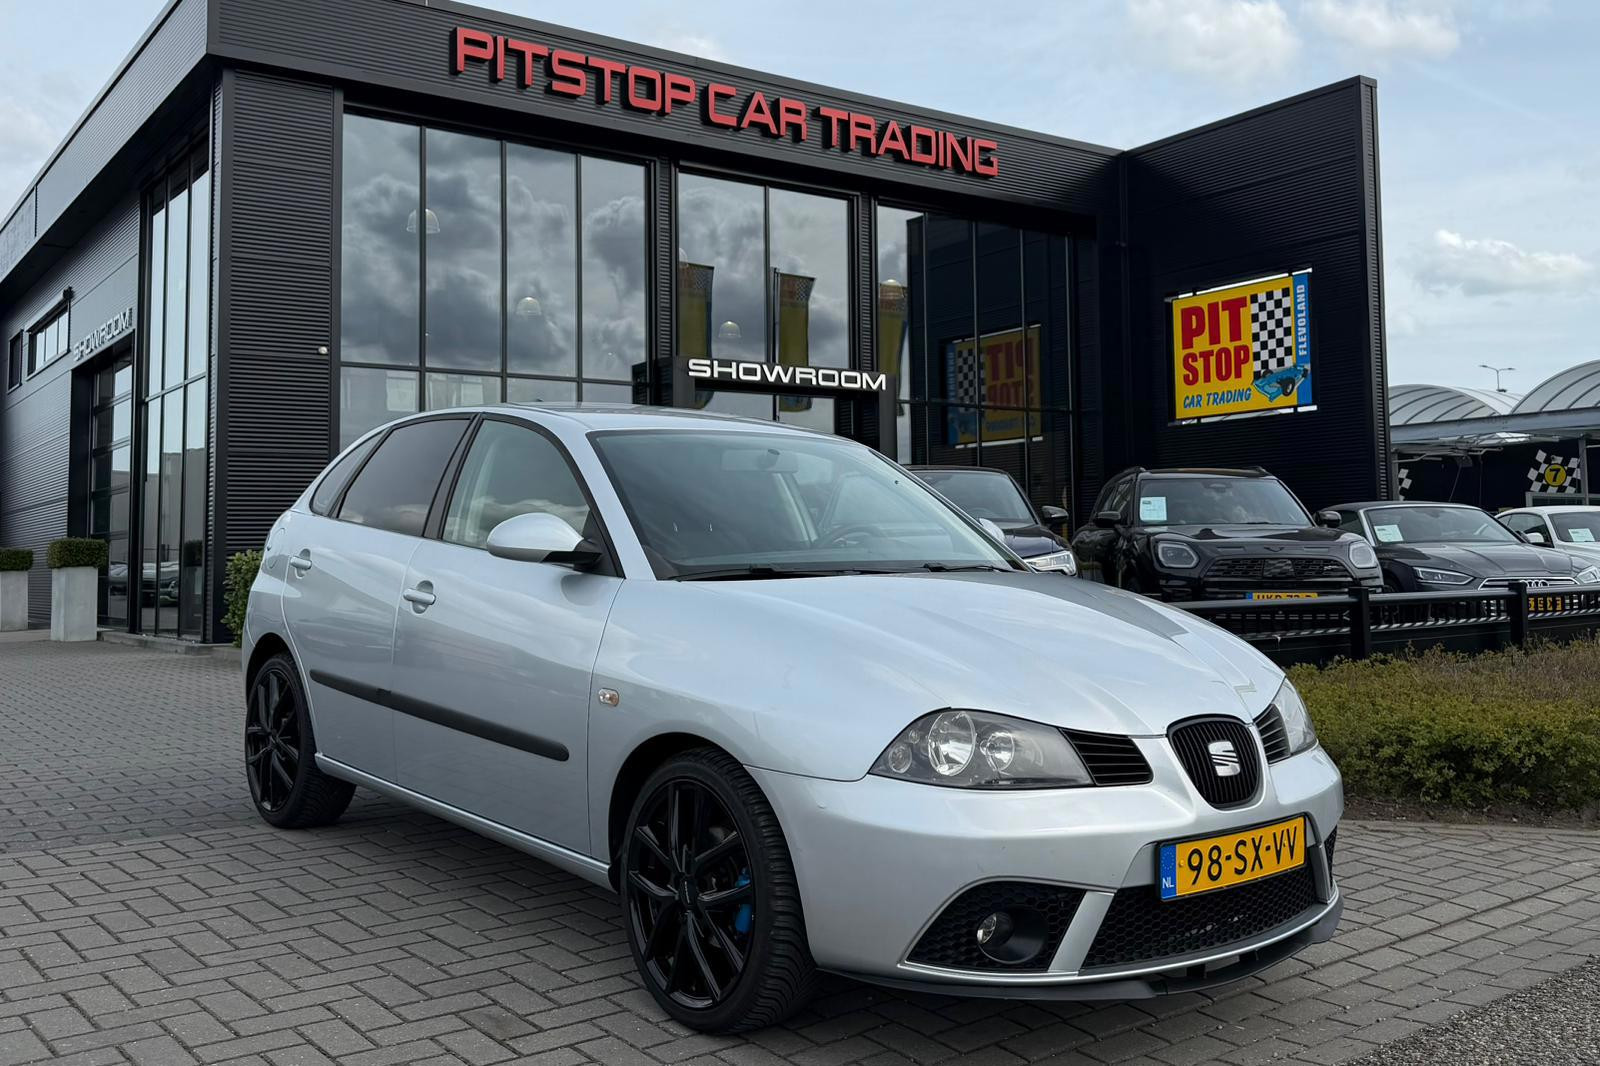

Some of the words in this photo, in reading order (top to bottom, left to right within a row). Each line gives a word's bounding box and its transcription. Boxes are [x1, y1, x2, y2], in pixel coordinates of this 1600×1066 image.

[455, 26, 697, 115] PITSTOP
[707, 82, 807, 142] CAR
[818, 105, 999, 178] TRADING
[1180, 295, 1248, 350] PIT
[1296, 284, 1308, 356] FLEVOLAND
[688, 358, 887, 391] SHOWROOM
[1182, 344, 1250, 386] STOP
[1183, 393, 1203, 409] CAR
[1206, 387, 1252, 407] TRADING
[1549, 467, 1561, 483] 7
[1186, 825, 1298, 886] 98-SX-VV
[1162, 876, 1175, 889] NL
